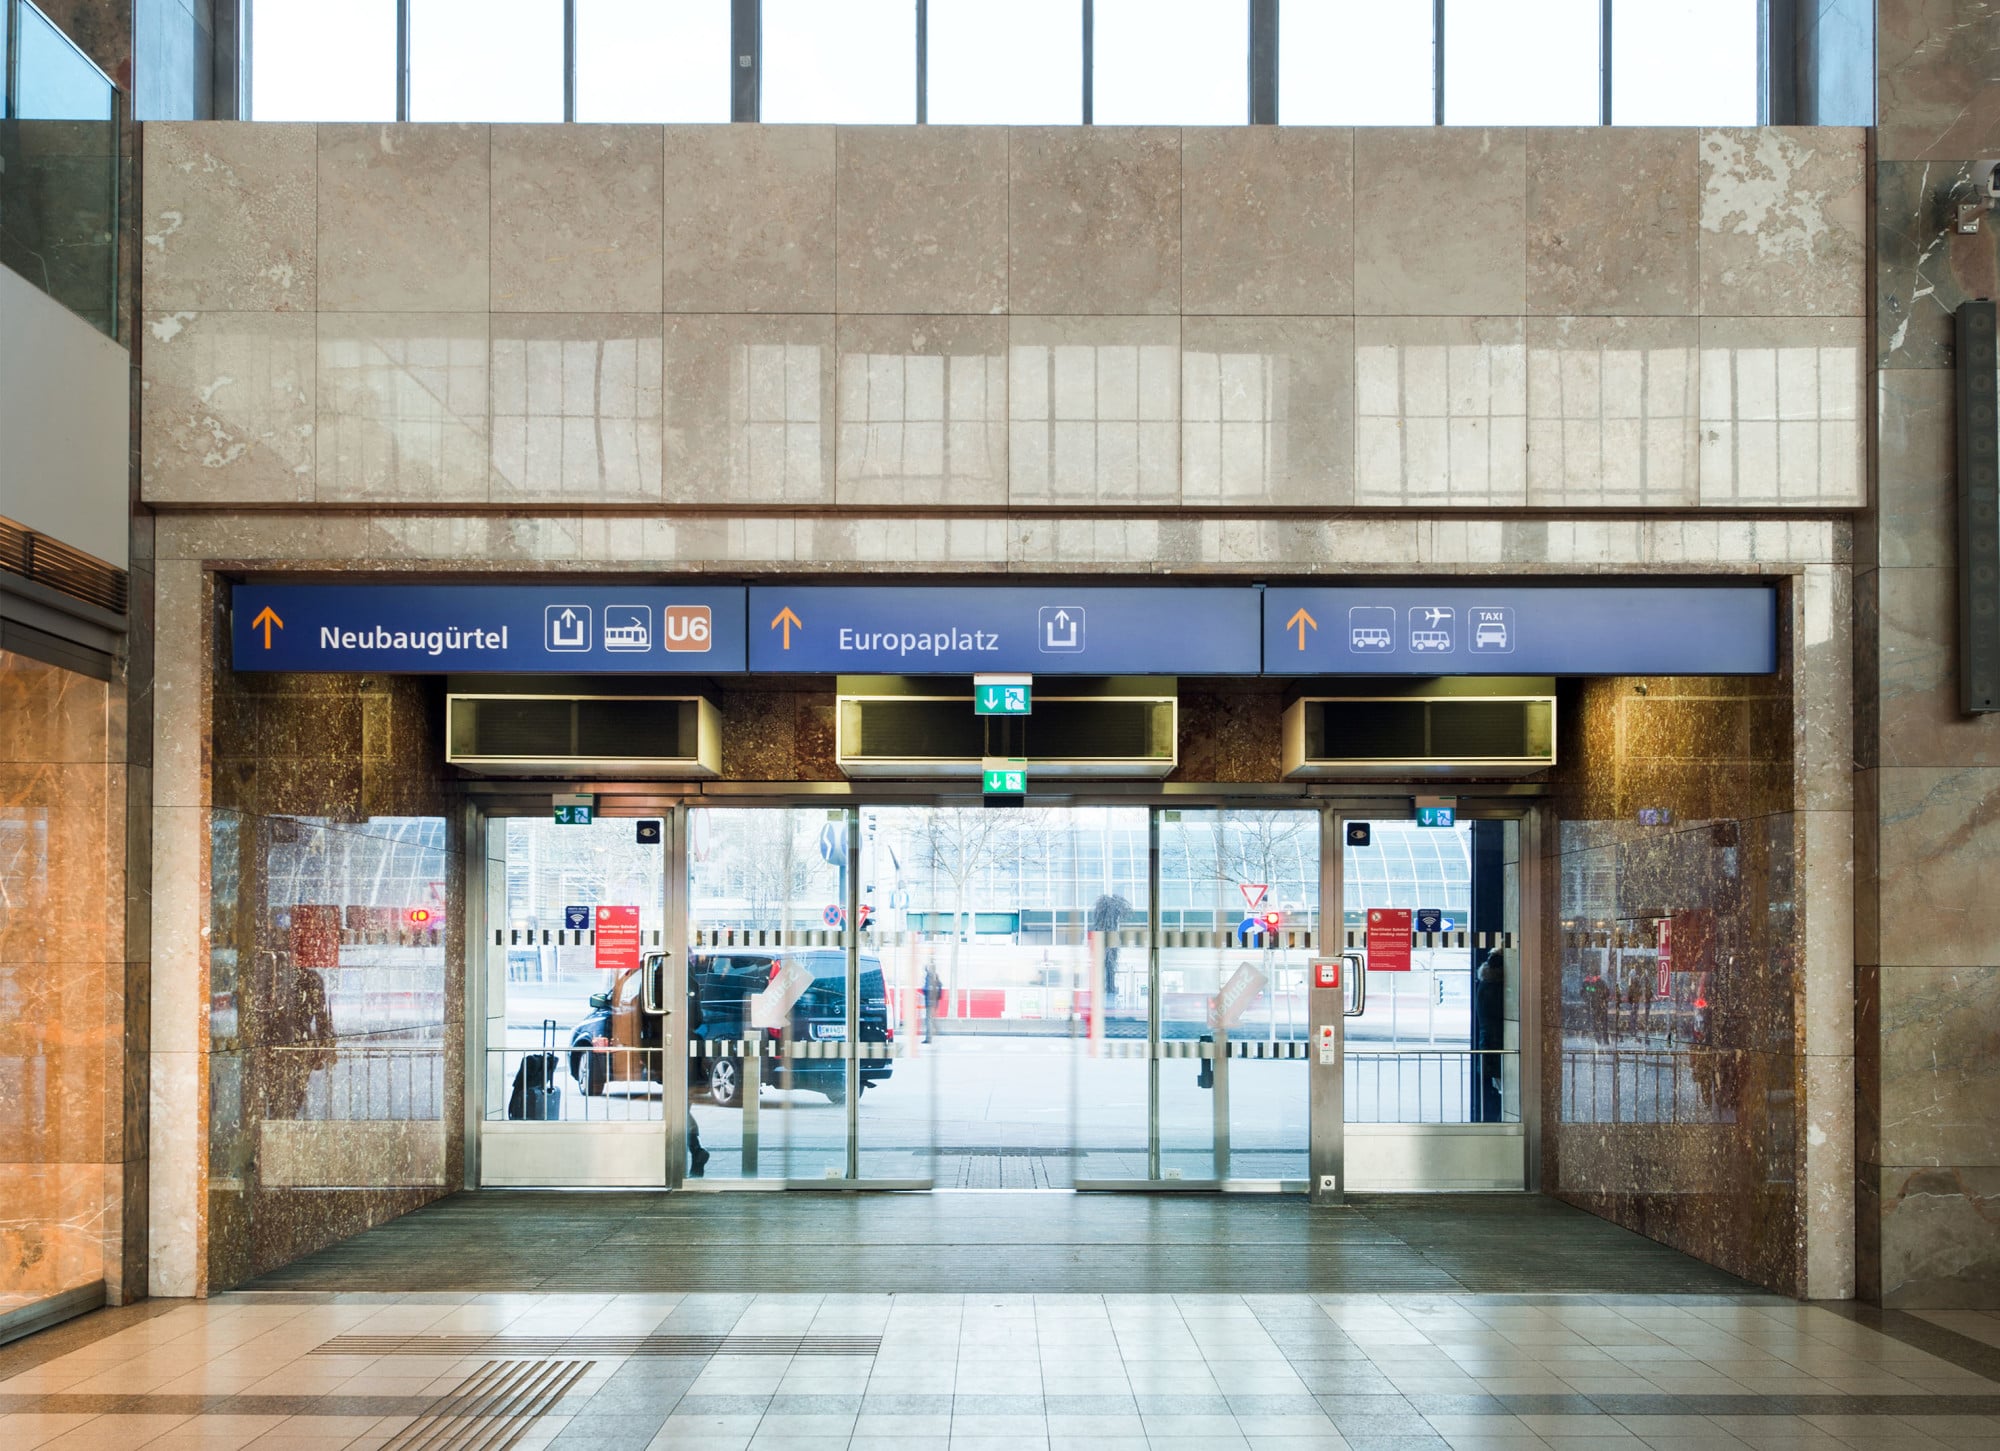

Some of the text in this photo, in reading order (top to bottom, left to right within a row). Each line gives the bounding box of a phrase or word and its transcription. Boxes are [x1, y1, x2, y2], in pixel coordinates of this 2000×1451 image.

[1479, 612, 1503, 621] TAXI
[320, 616, 709, 655] Neubaugürtel U6
[839, 627, 999, 656] Europaplatz
